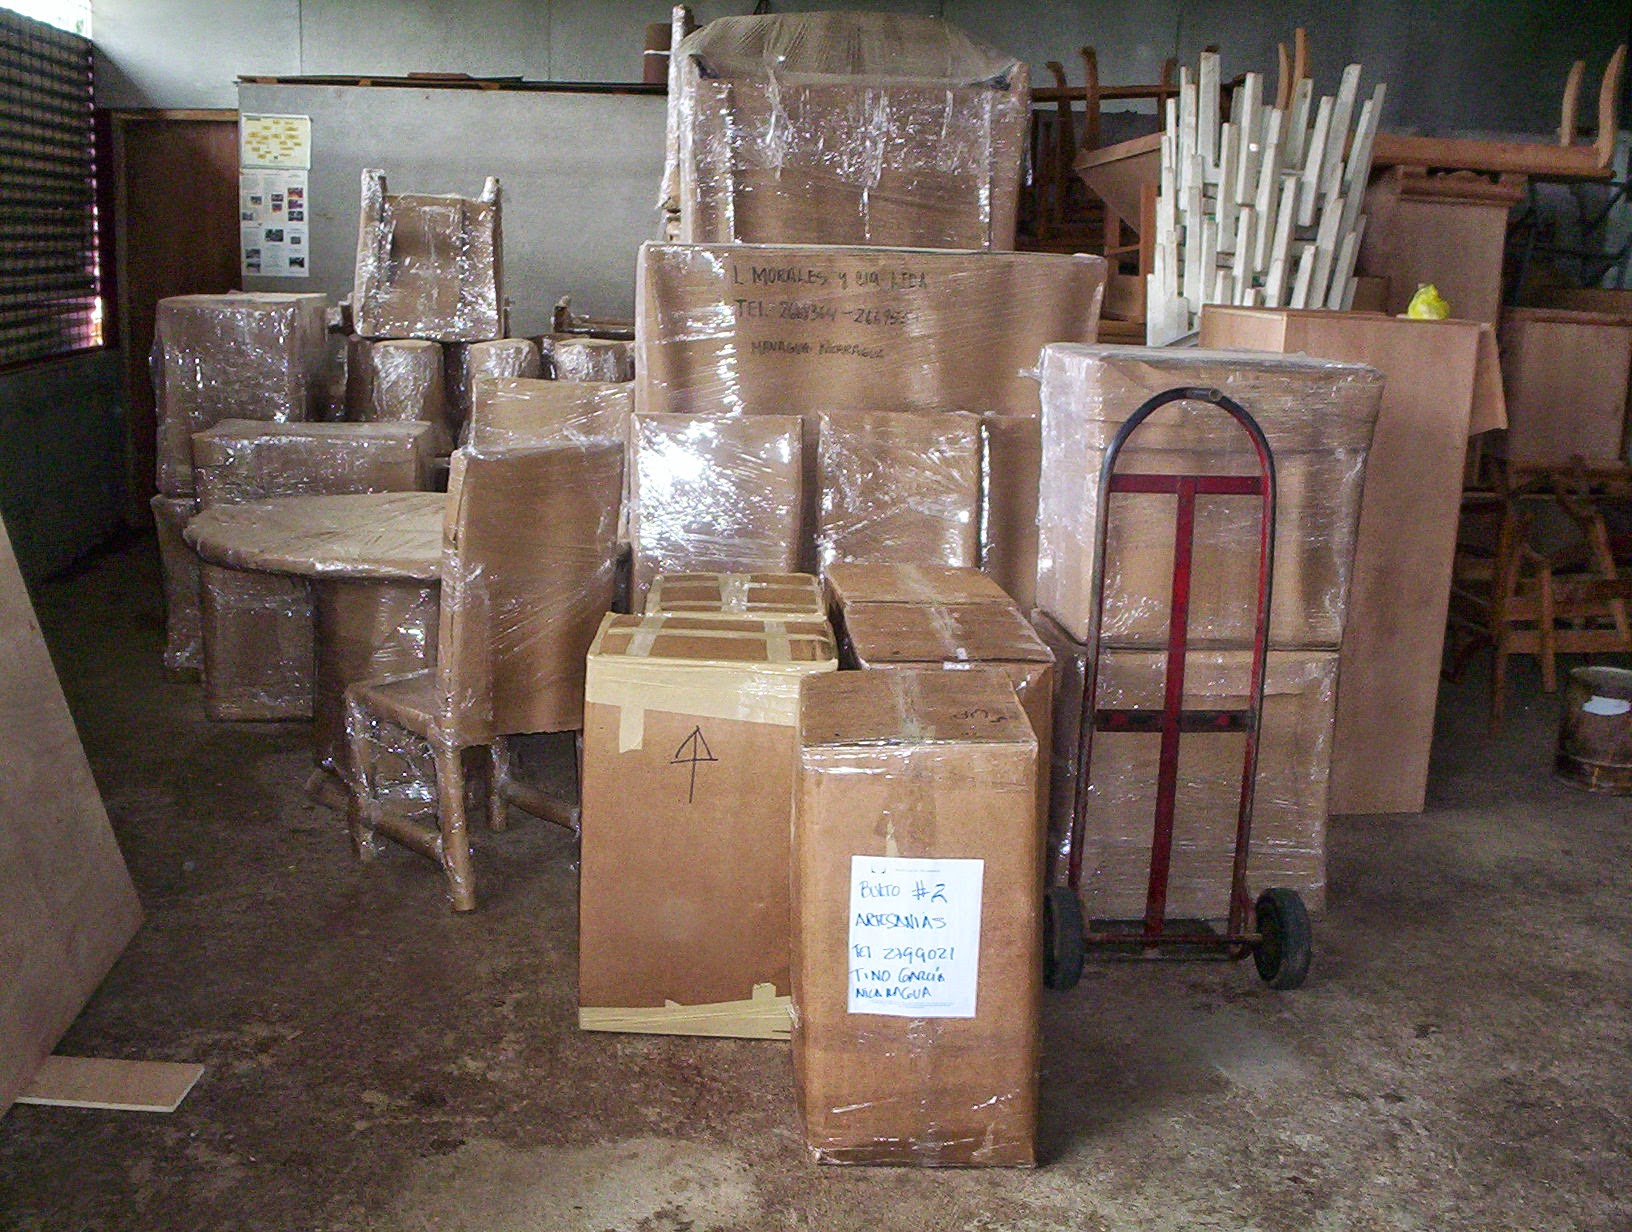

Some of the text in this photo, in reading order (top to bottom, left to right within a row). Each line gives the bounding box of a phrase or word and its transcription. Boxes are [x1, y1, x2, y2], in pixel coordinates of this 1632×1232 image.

[734, 265, 744, 286] L
[752, 265, 828, 287] MORALES
[912, 880, 948, 903] #2
